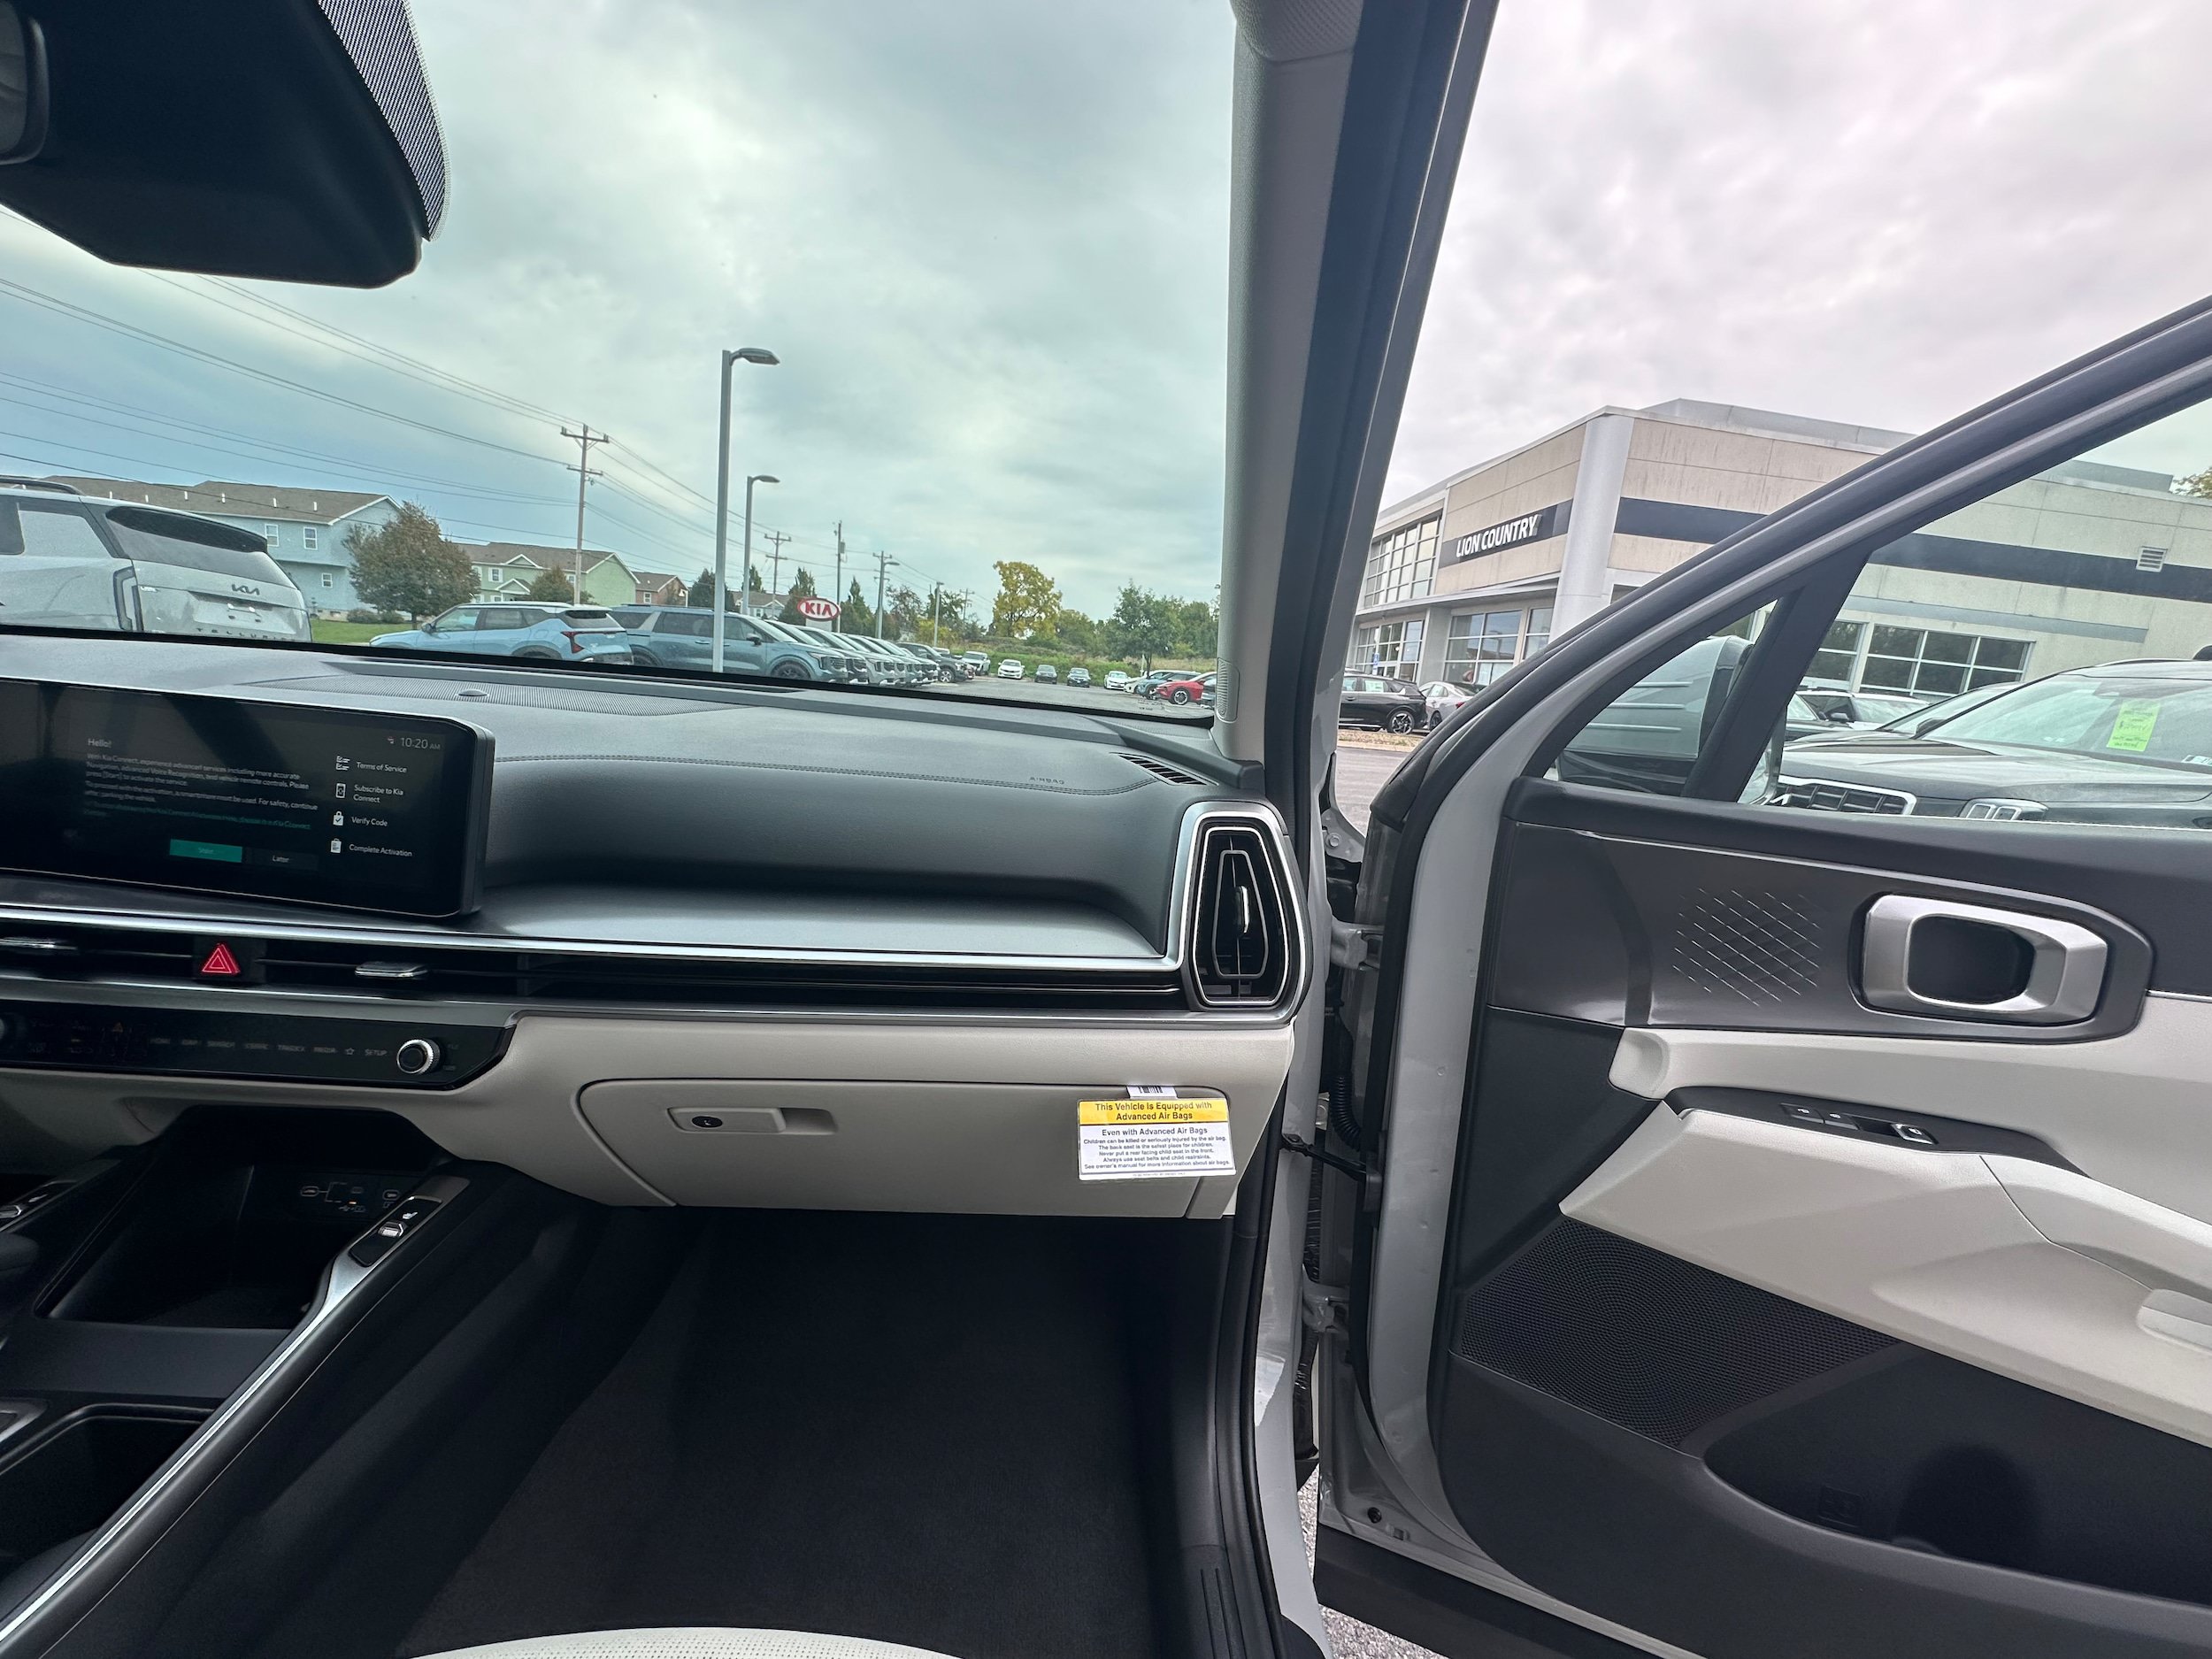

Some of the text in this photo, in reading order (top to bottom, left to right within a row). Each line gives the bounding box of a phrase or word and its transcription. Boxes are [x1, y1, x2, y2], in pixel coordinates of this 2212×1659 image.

[1456, 514, 1540, 557] LION COUNTRY
[805, 602, 833, 616] KIA
[401, 737, 428, 749] 10:20
[1029, 776, 1064, 785] AIRBAG
[354, 784, 385, 795] Subscribe
[353, 794, 380, 803] Connect
[351, 816, 370, 826] Verify
[349, 843, 412, 857] Complete Activation
[365, 1048, 388, 1056] SETUP
[1156, 1102, 1194, 1112] Equipped
[1195, 1101, 1212, 1110] with
[1116, 1112, 1156, 1121] Advanced
[1172, 1111, 1193, 1121] Bags
[1189, 1126, 1208, 1135] Bags
